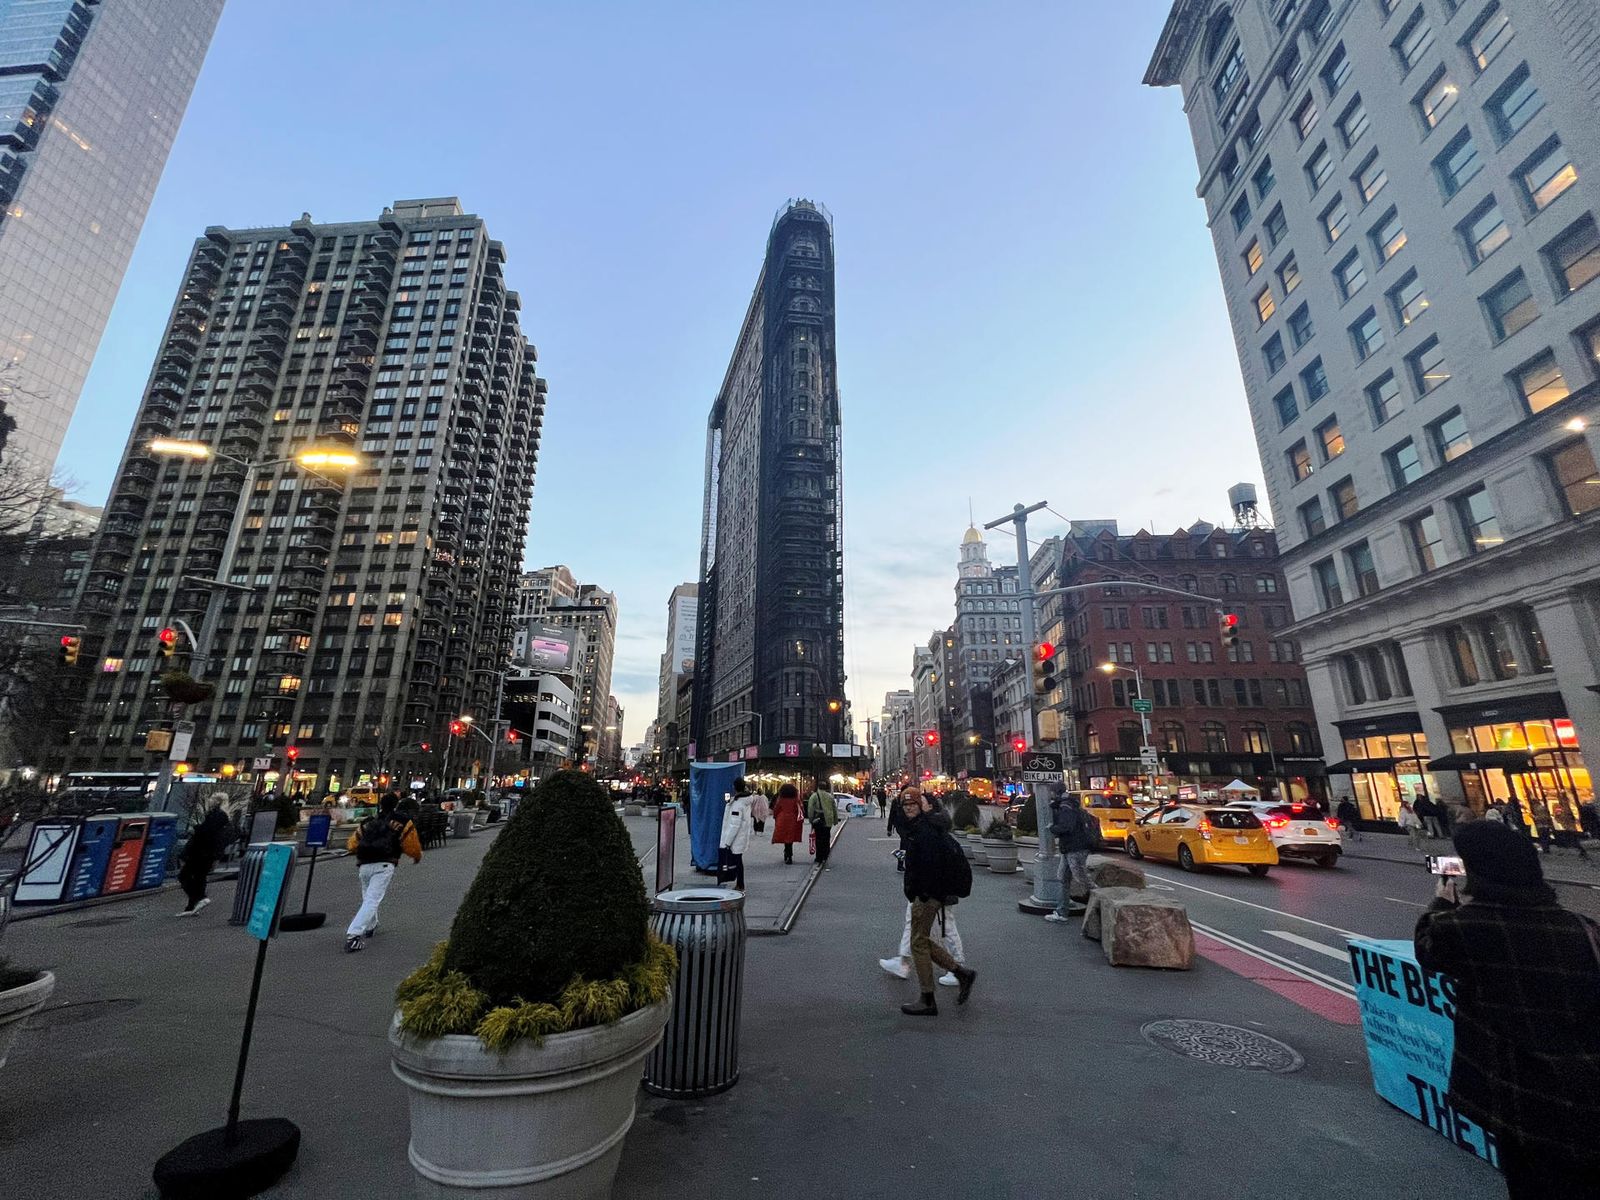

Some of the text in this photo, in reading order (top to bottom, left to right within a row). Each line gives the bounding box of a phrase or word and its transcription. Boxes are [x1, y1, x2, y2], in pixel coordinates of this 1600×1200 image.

[1024, 772, 1062, 782] BIKE LANE
[1347, 945, 1401, 999] THE
[1407, 1073, 1478, 1156] THE
